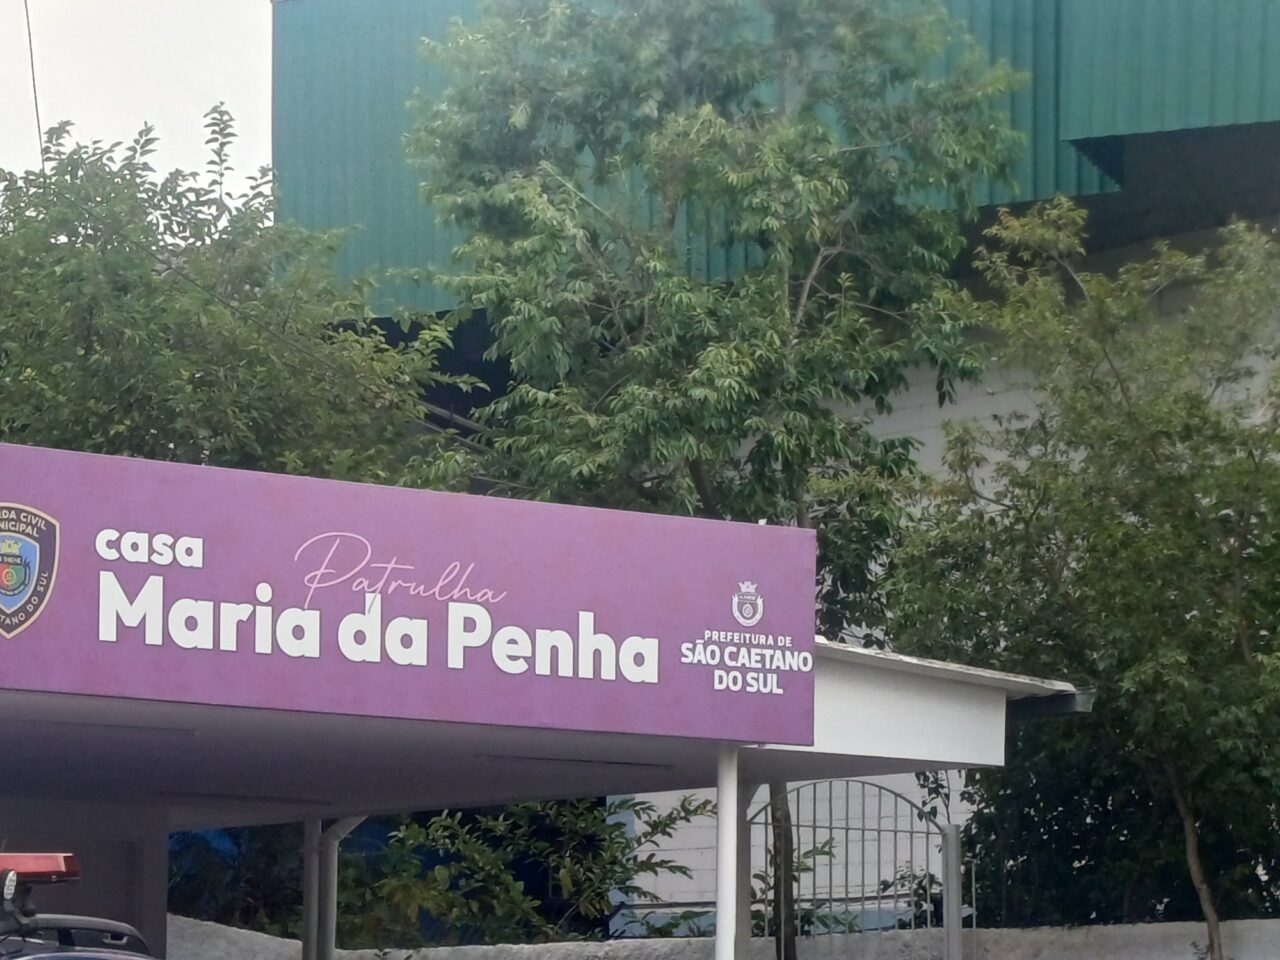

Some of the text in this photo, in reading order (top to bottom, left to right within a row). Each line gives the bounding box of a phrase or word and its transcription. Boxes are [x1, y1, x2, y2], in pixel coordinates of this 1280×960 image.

[20, 513, 47, 531] CIVIL
[95, 528, 204, 568] casa
[294, 532, 507, 614] Patrulha
[26, 596, 39, 612] DO
[37, 571, 49, 593] SUL
[98, 570, 659, 684] Maria da Penha
[704, 630, 792, 647] PREFEITURA DE
[680, 639, 813, 672] SÃO CAETANO
[713, 669, 784, 694] DO SUL
